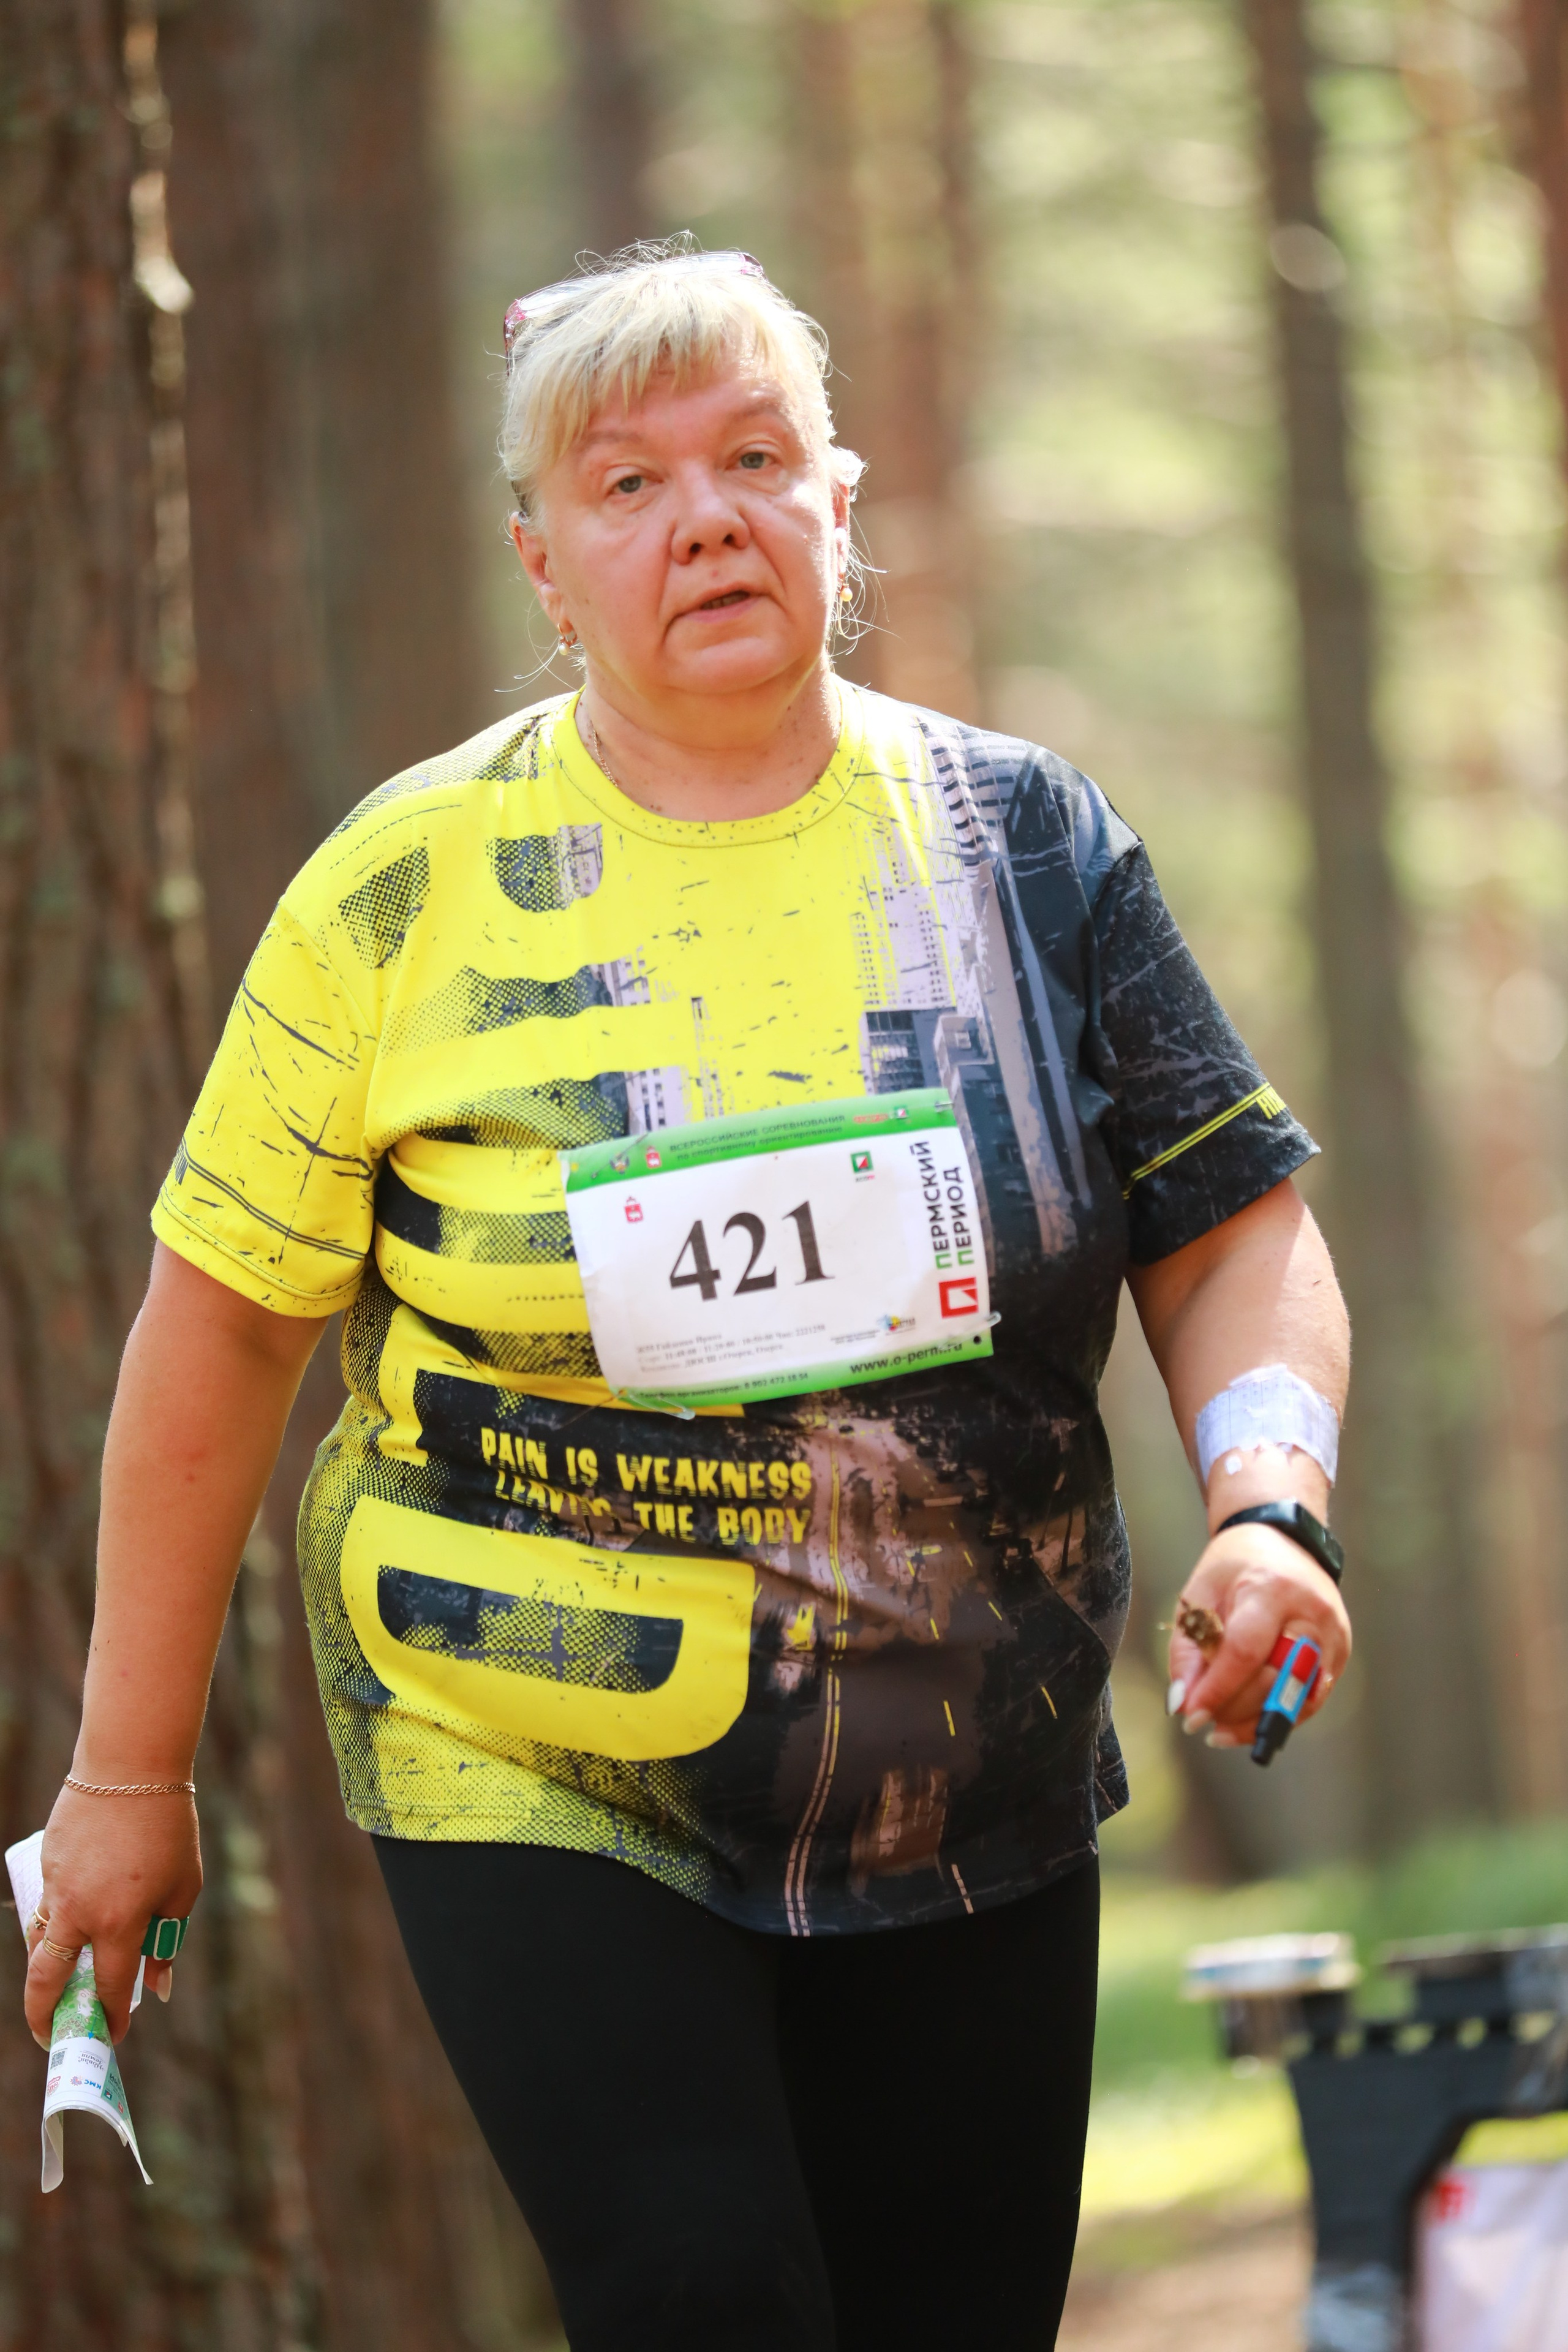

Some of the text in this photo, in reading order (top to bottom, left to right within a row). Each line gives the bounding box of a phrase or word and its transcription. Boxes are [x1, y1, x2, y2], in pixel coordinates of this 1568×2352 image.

[669, 1129, 759, 1152] ВСЕРОССИЙСКИЕ
[761, 1115, 845, 1134] СОРЕВНОВАНИЯ
[692, 1140, 756, 1159] спортивному
[759, 1126, 843, 1147] ориентированию
[909, 1140, 952, 1270] ПЕРМСКИЙ
[943, 1166, 975, 1267] ПЕРИОД
[669, 1199, 836, 1303] 421
[745, 1381, 750, 1390] 8
[752, 1378, 768, 1388] 902
[770, 1374, 786, 1385] 472
[481, 1426, 812, 1501] PAIN IS WEAKNESS
[632, 1501, 696, 1544] THE
[717, 1506, 812, 1546] BODY
